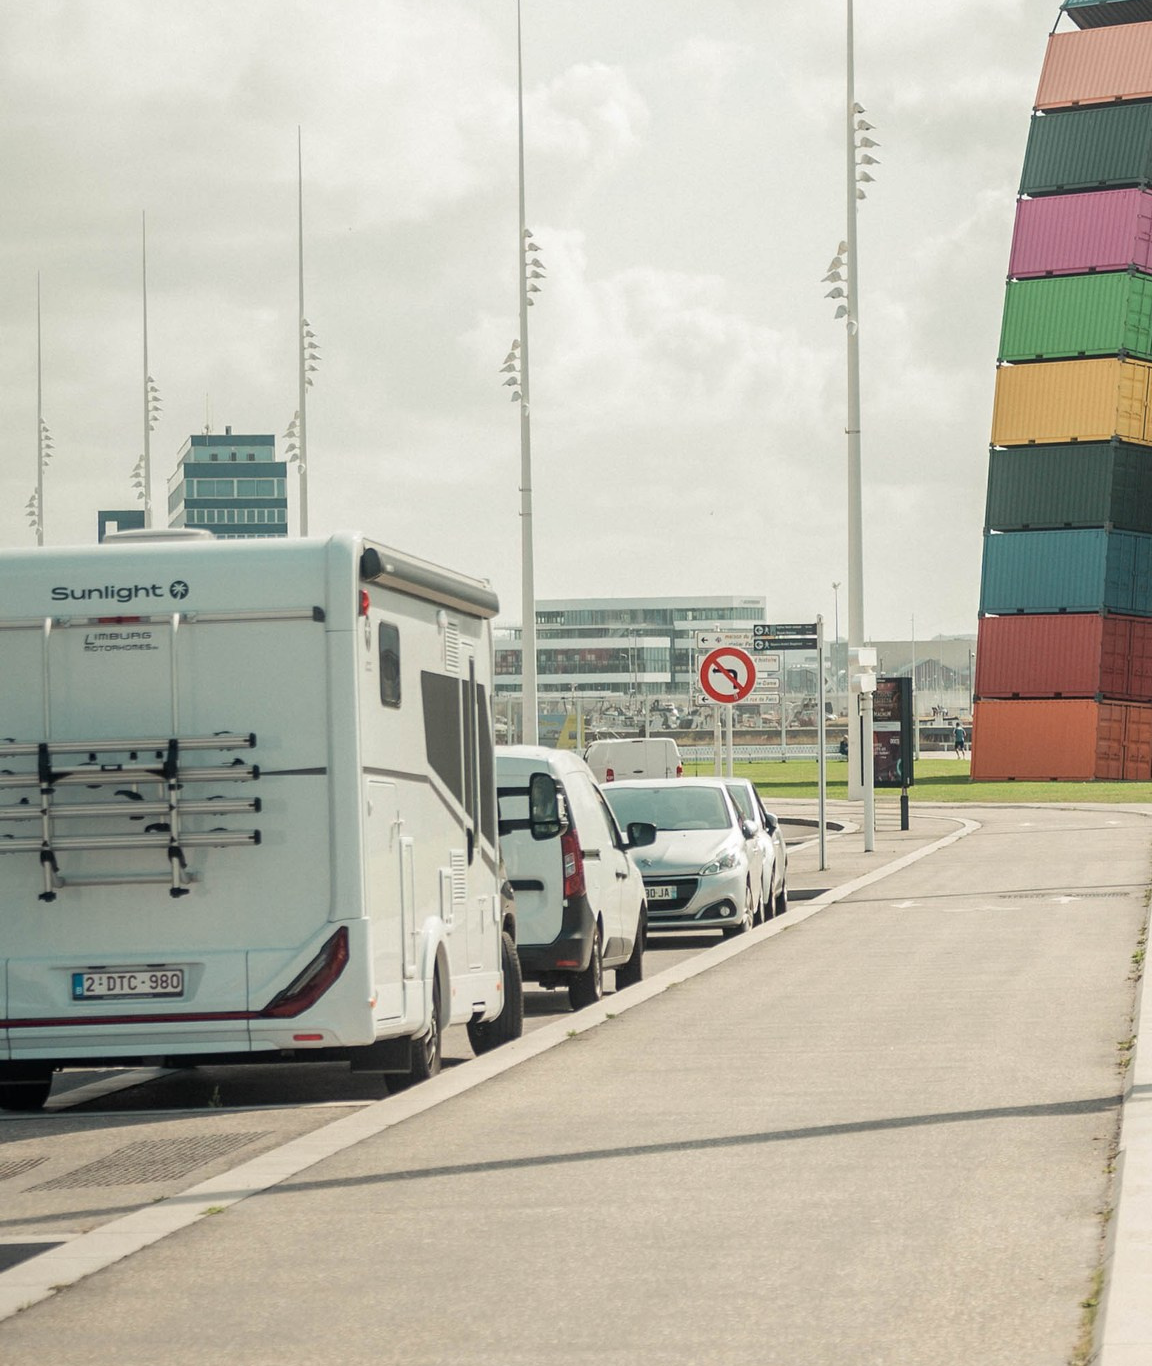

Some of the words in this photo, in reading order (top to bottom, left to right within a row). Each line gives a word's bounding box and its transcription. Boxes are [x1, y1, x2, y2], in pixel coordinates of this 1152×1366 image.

[51, 584, 164, 603] Sunlight
[84, 632, 152, 645] LIMBURG
[85, 974, 180, 993] 2-DTC-980
